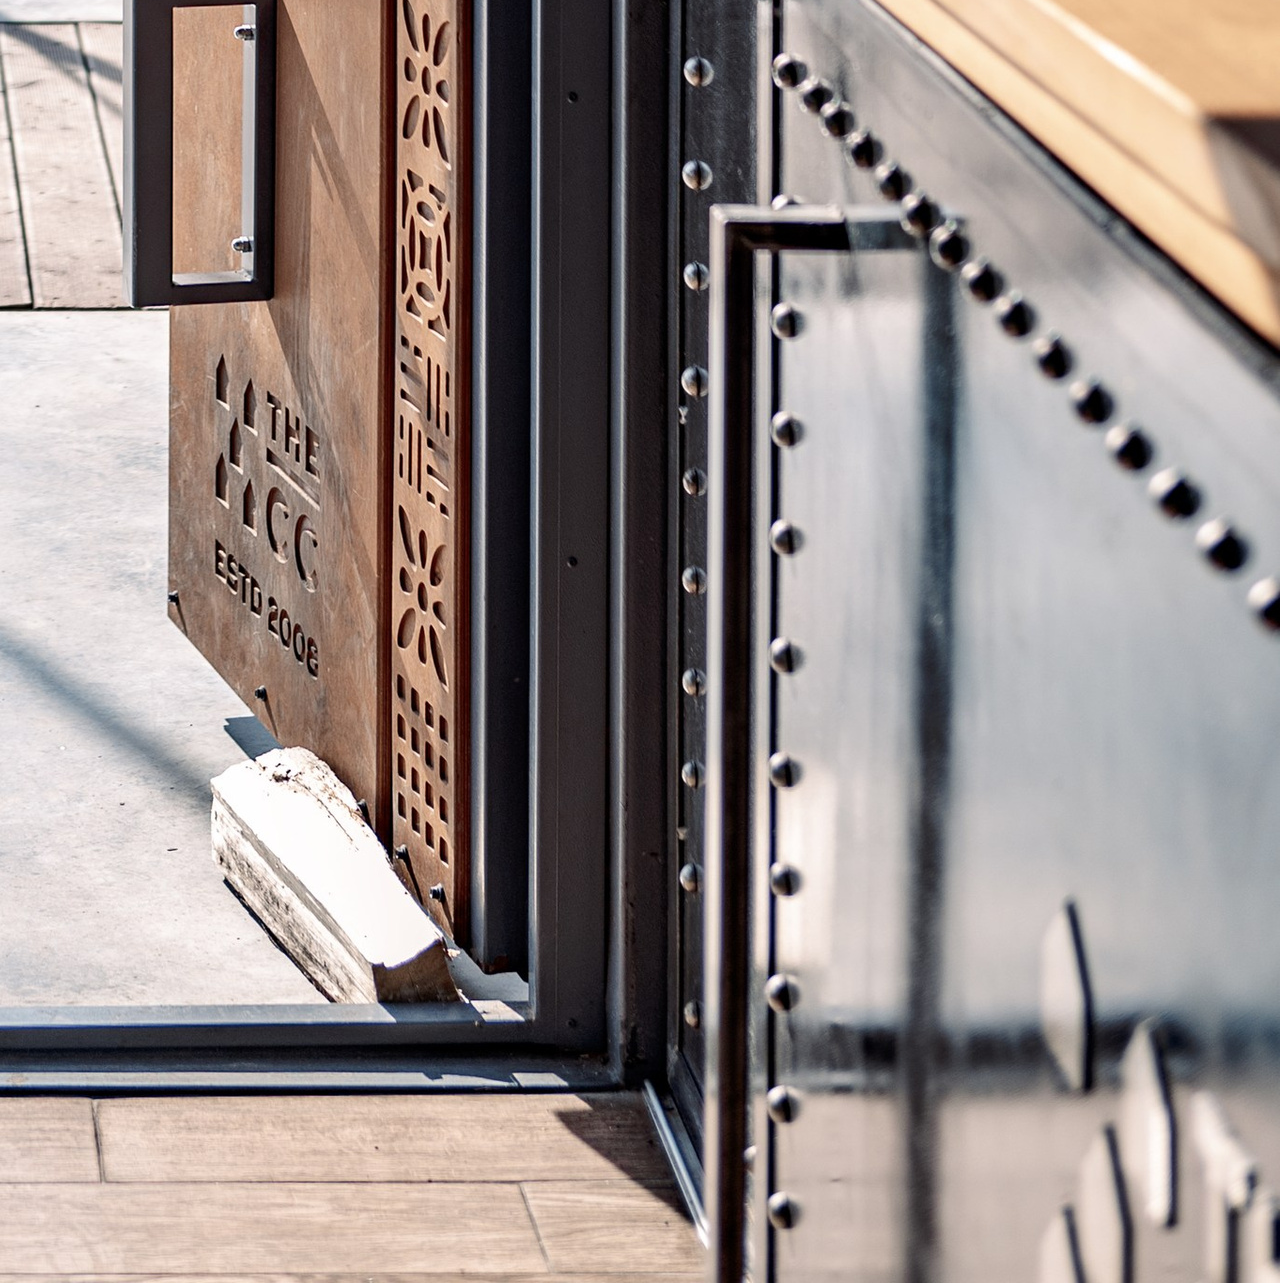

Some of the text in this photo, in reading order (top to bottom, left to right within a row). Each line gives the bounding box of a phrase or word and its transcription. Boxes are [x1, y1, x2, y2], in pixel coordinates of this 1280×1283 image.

[266, 390, 320, 483] THE
[266, 486, 318, 593] CC
[215, 538, 319, 681] ESTD 2008
